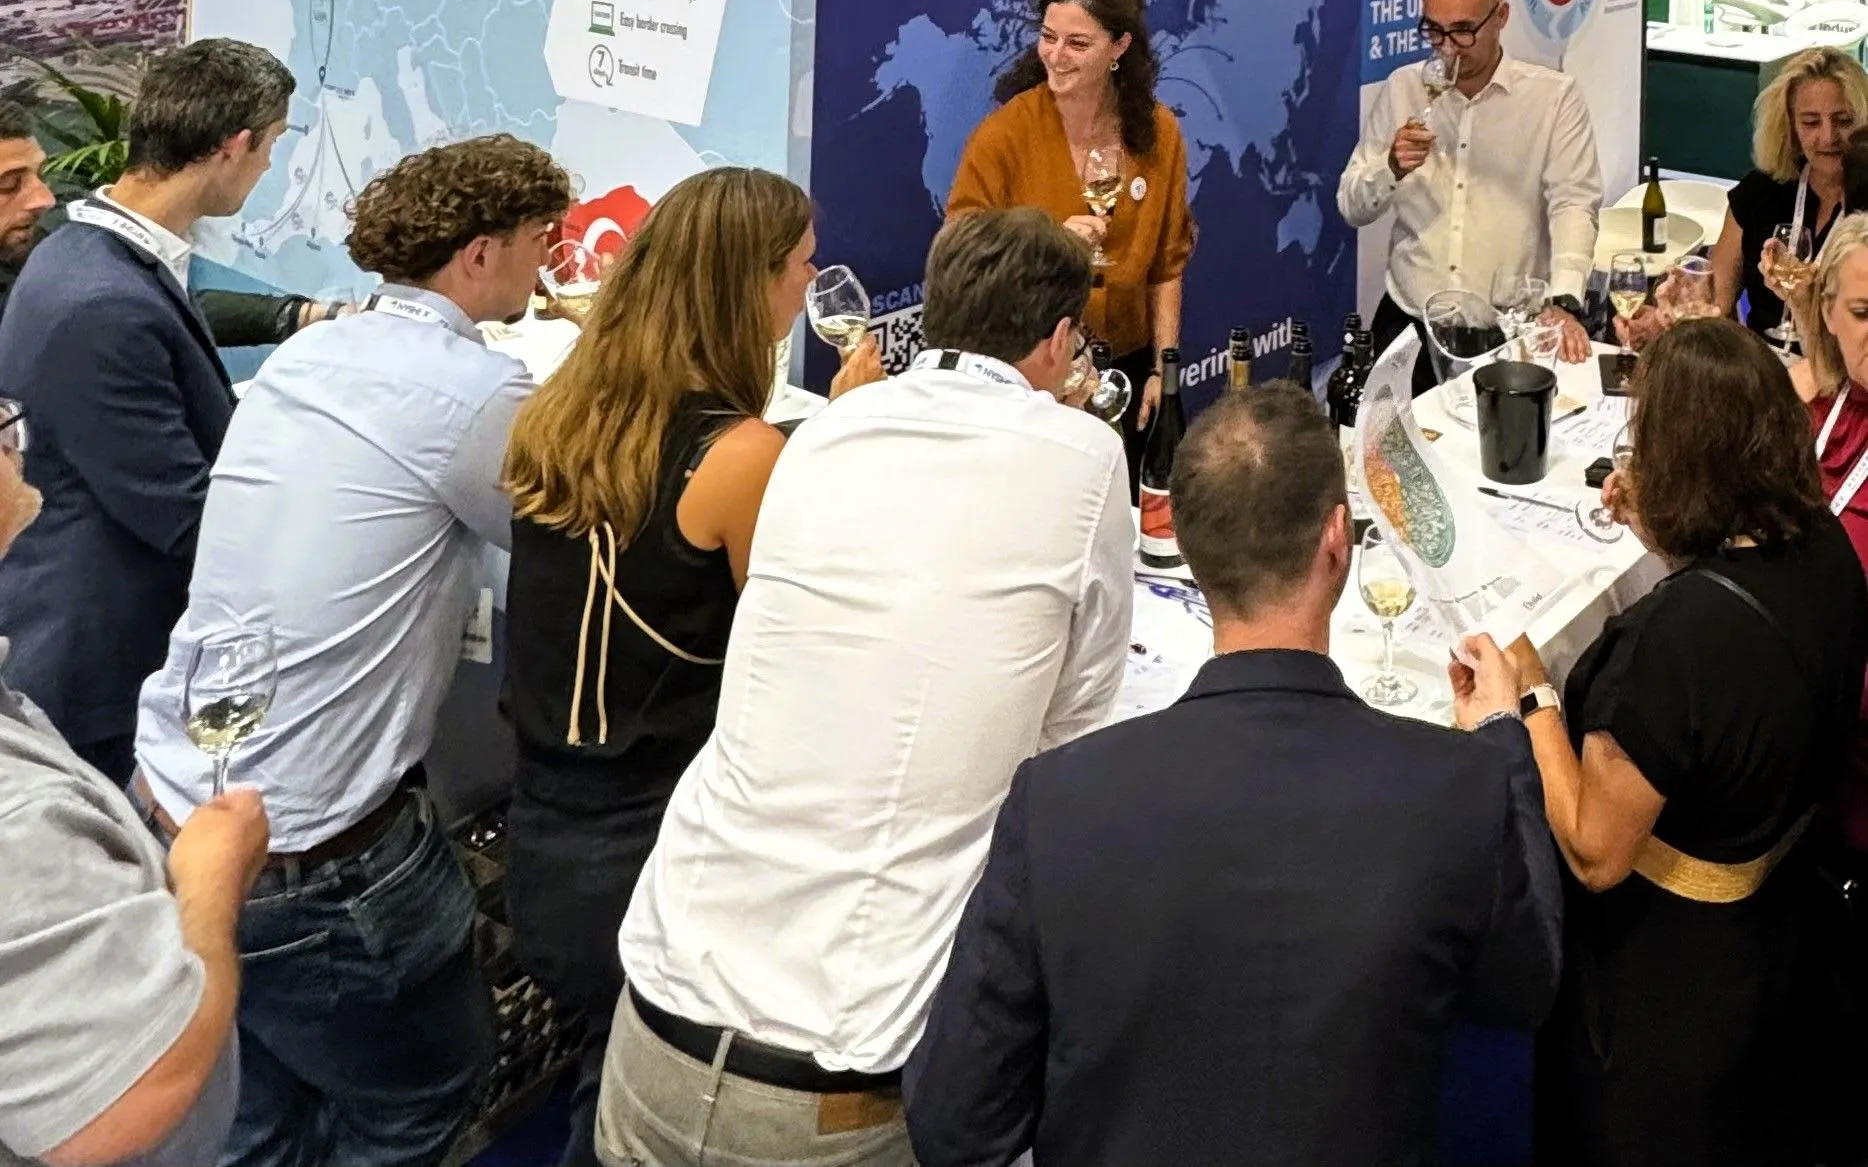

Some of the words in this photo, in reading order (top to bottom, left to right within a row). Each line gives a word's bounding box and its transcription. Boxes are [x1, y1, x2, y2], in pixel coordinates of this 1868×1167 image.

[619, 11, 635, 31] Easy
[1370, 34, 1383, 61] &
[1385, 29, 1419, 57] THE
[872, 282, 926, 315] SCAN
